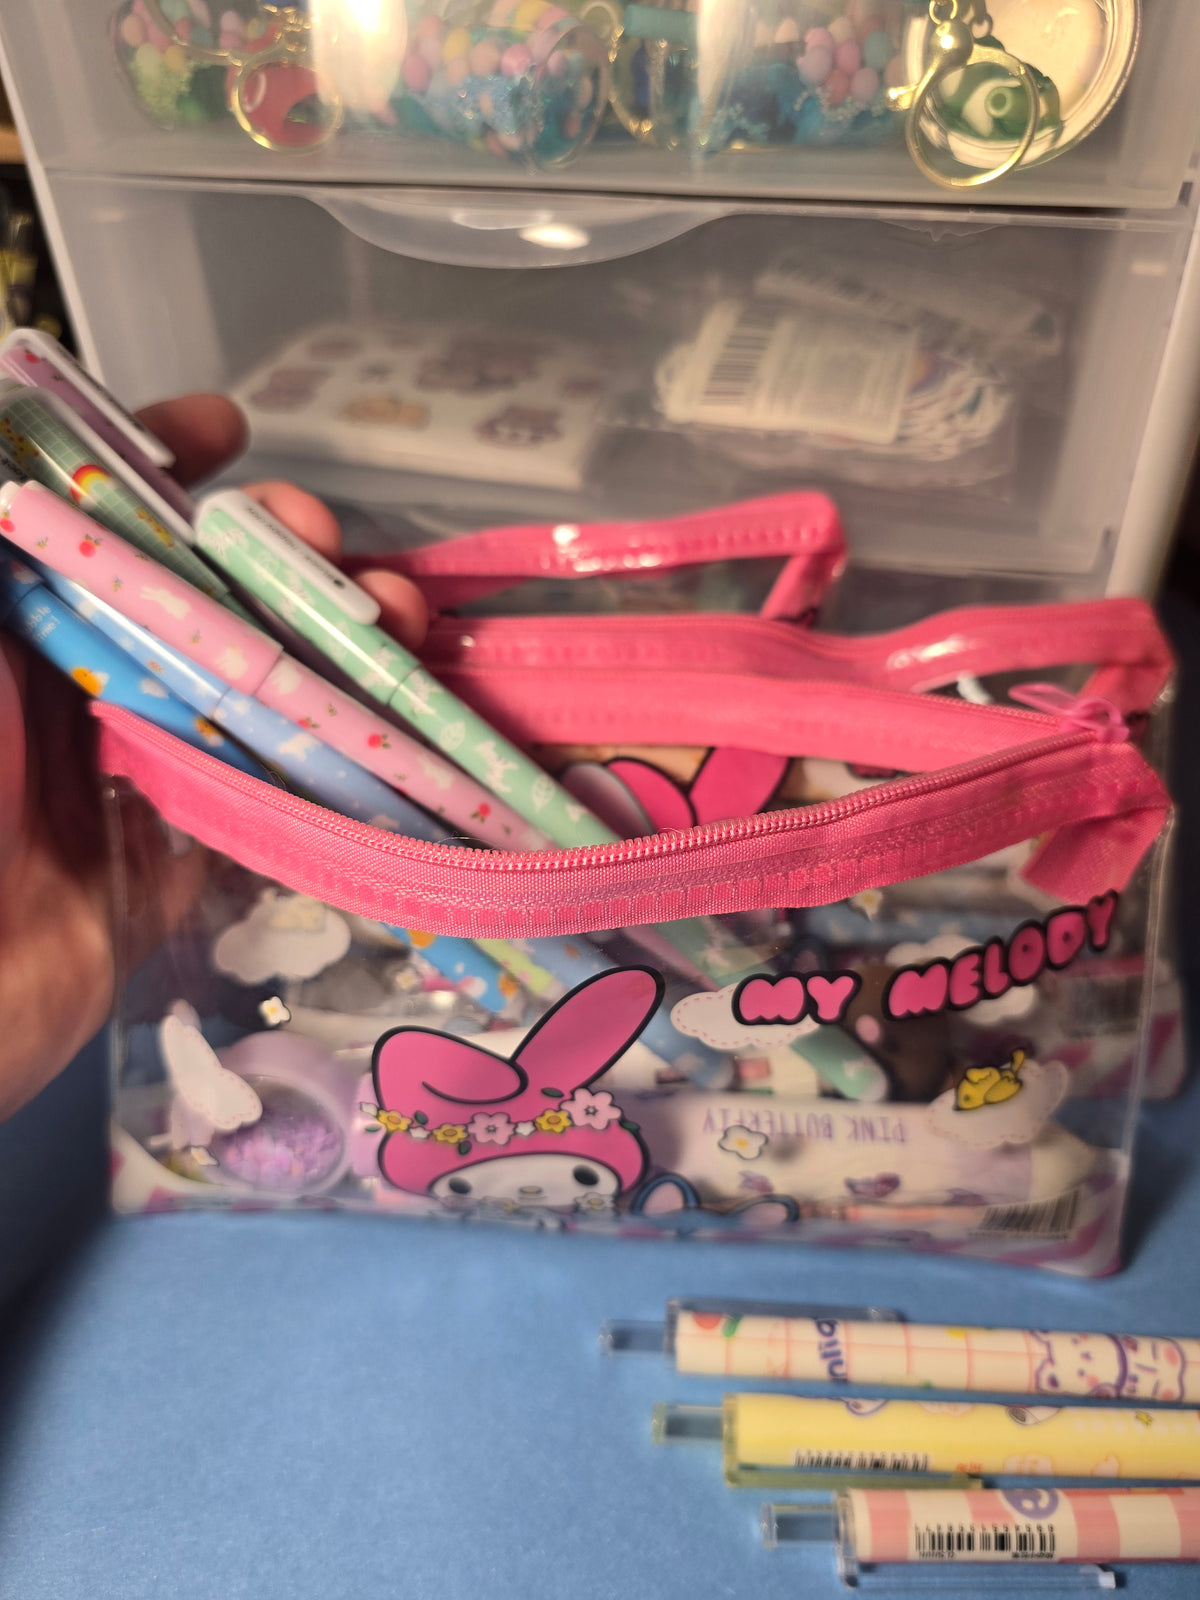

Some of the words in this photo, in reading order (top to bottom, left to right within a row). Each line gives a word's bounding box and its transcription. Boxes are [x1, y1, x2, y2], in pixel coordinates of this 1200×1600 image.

[733, 973, 860, 1024] MY
[884, 890, 1118, 1020] MELODY
[844, 1114, 907, 1144] PINK
